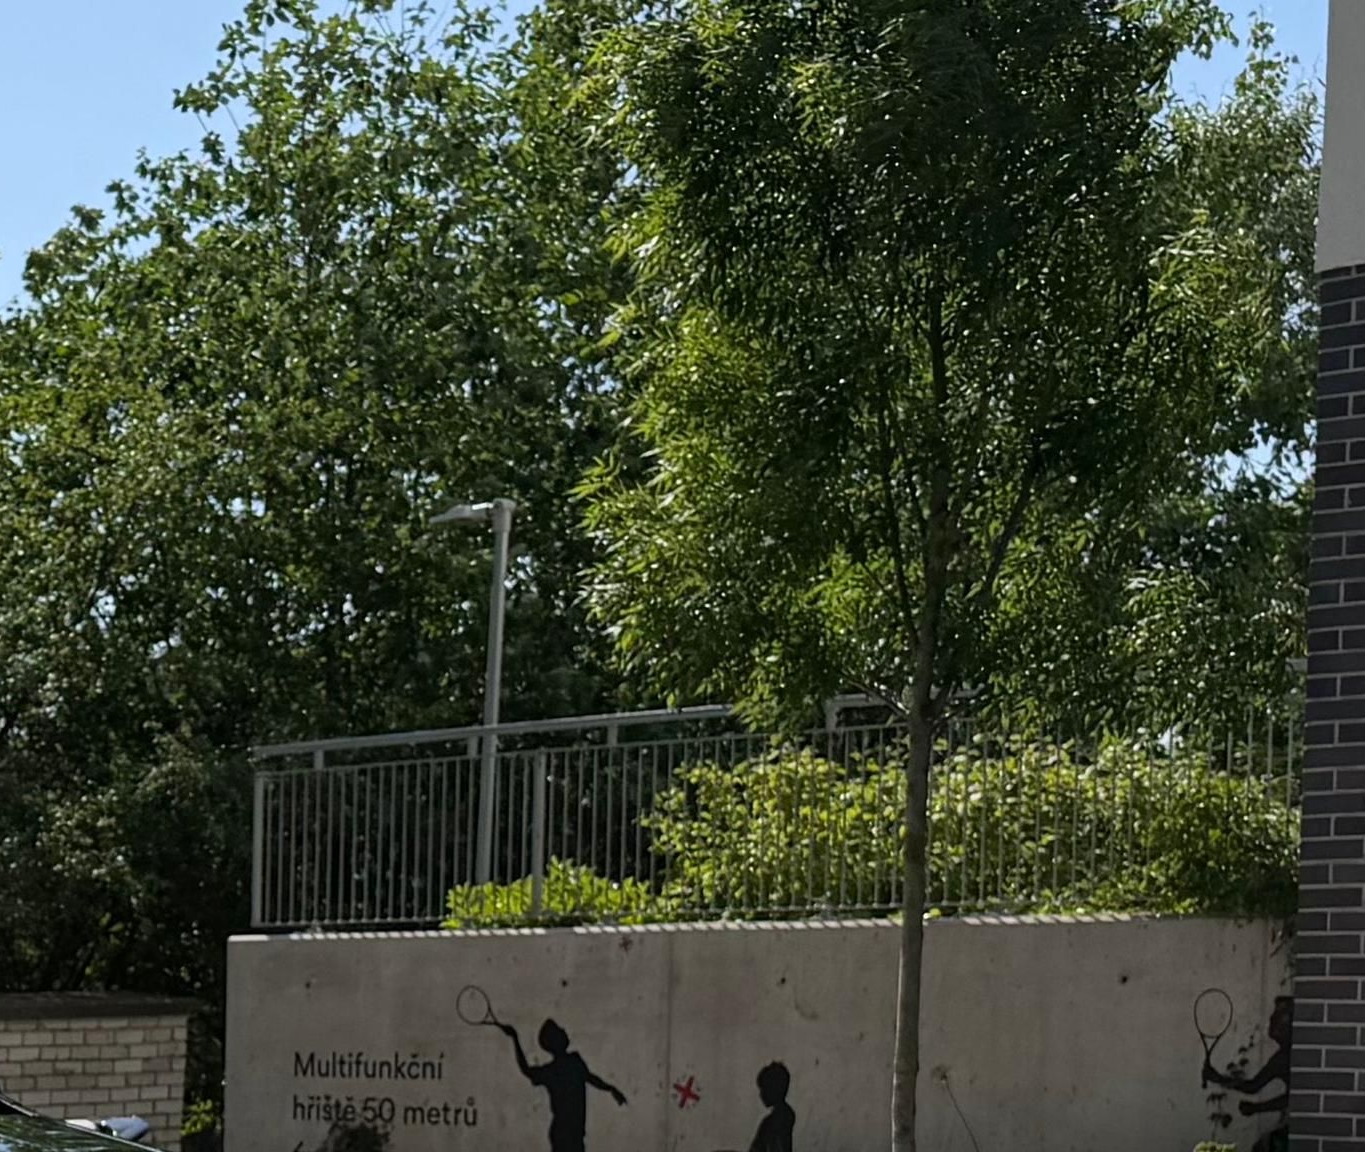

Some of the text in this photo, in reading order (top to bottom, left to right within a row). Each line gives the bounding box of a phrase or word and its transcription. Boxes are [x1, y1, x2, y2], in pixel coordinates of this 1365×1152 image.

[293, 1052, 445, 1081] Multifunkční
[292, 1095, 478, 1126] hřiště 50 metrů
